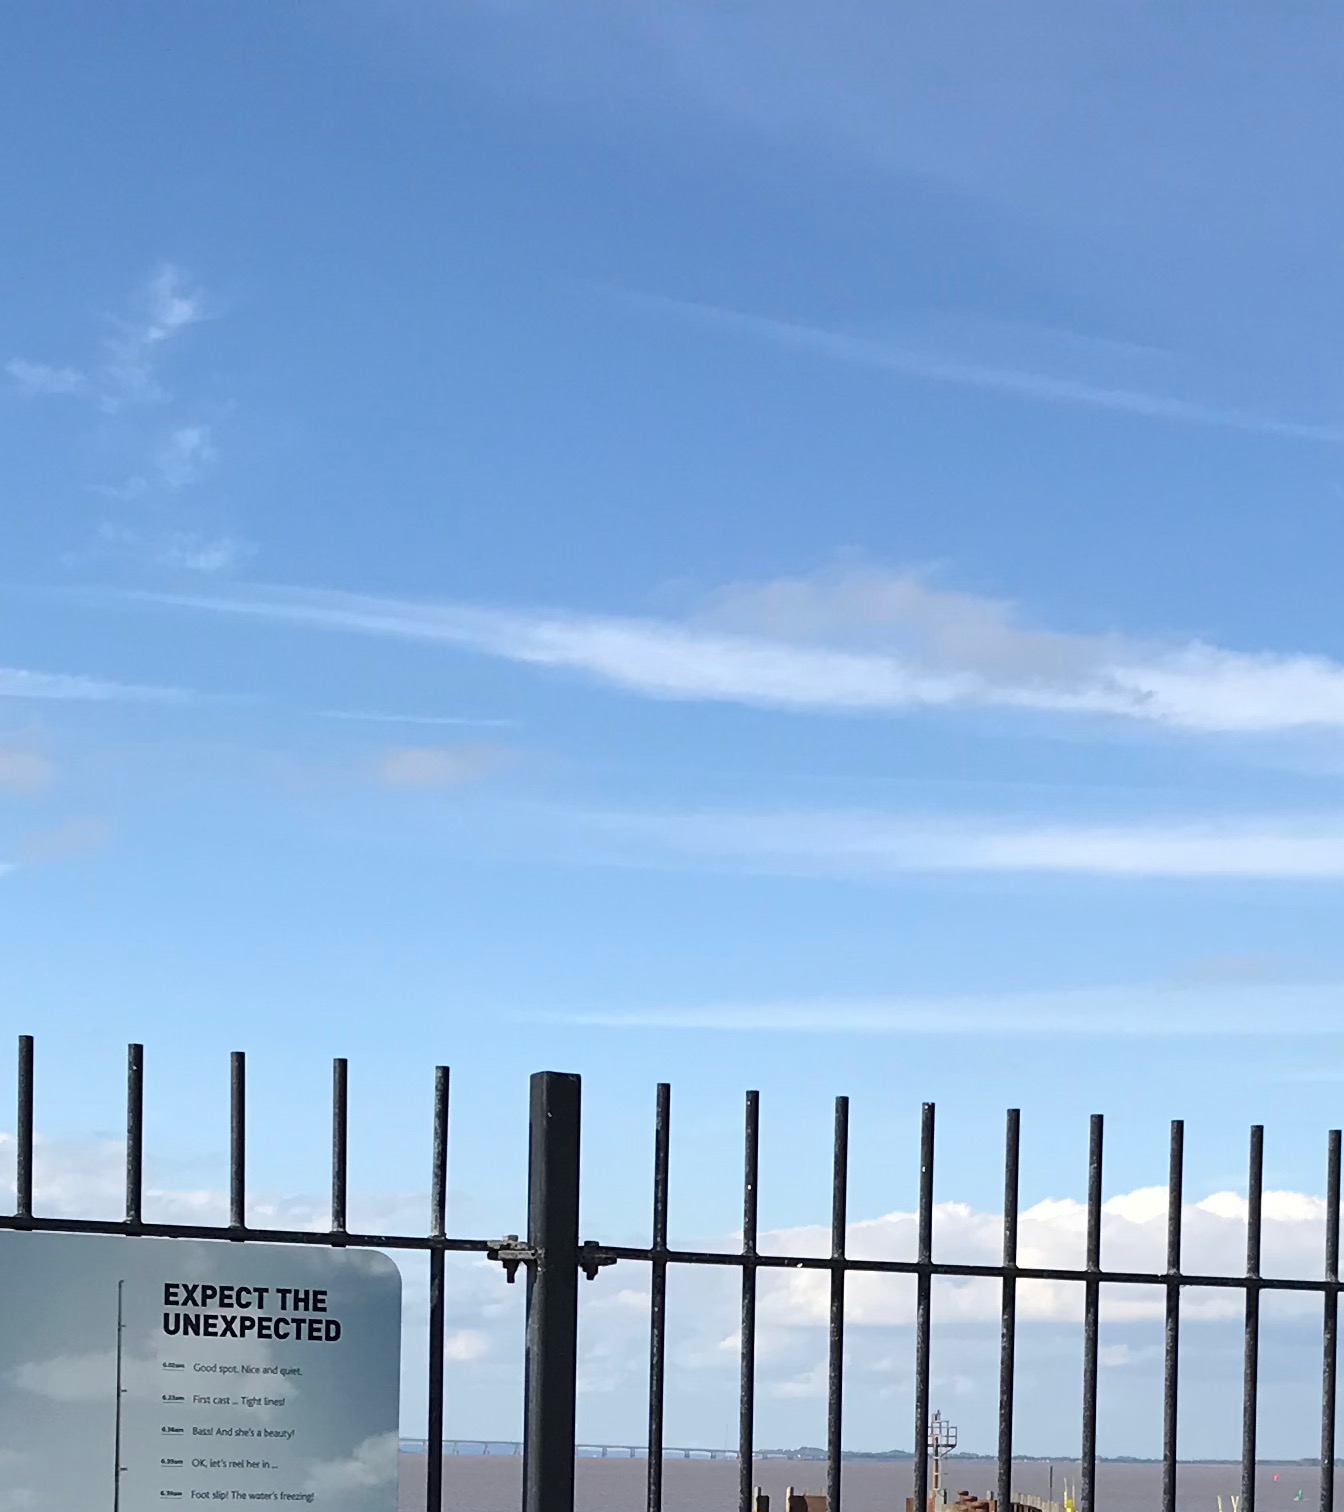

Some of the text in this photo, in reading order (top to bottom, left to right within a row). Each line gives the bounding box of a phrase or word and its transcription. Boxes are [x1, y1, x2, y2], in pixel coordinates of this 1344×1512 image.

[164, 1283, 327, 1312] EXPECT THE
[163, 1312, 341, 1342] UNEXPECTED
[193, 1363, 217, 1373] Good
[241, 1365, 260, 1374] Nice
[262, 1366, 278, 1375] and
[193, 1395, 211, 1404] First
[213, 1397, 230, 1405] cast
[241, 1396, 262, 1407] Tight
[264, 1397, 286, 1406] lines!
[192, 1427, 213, 1436] Bass!
[216, 1428, 233, 1437] And
[235, 1428, 255, 1437] she's
[263, 1429, 295, 1440] beauty!
[209, 1459, 227, 1468] let's
[229, 1460, 244, 1468] reel
[246, 1460, 260, 1468] her
[262, 1460, 270, 1469] in
[191, 1490, 210, 1500] Foot
[212, 1490, 229, 1501] slip!
[231, 1491, 247, 1500] The
[248, 1491, 278, 1500] water's
[280, 1492, 315, 1503] freezing!
